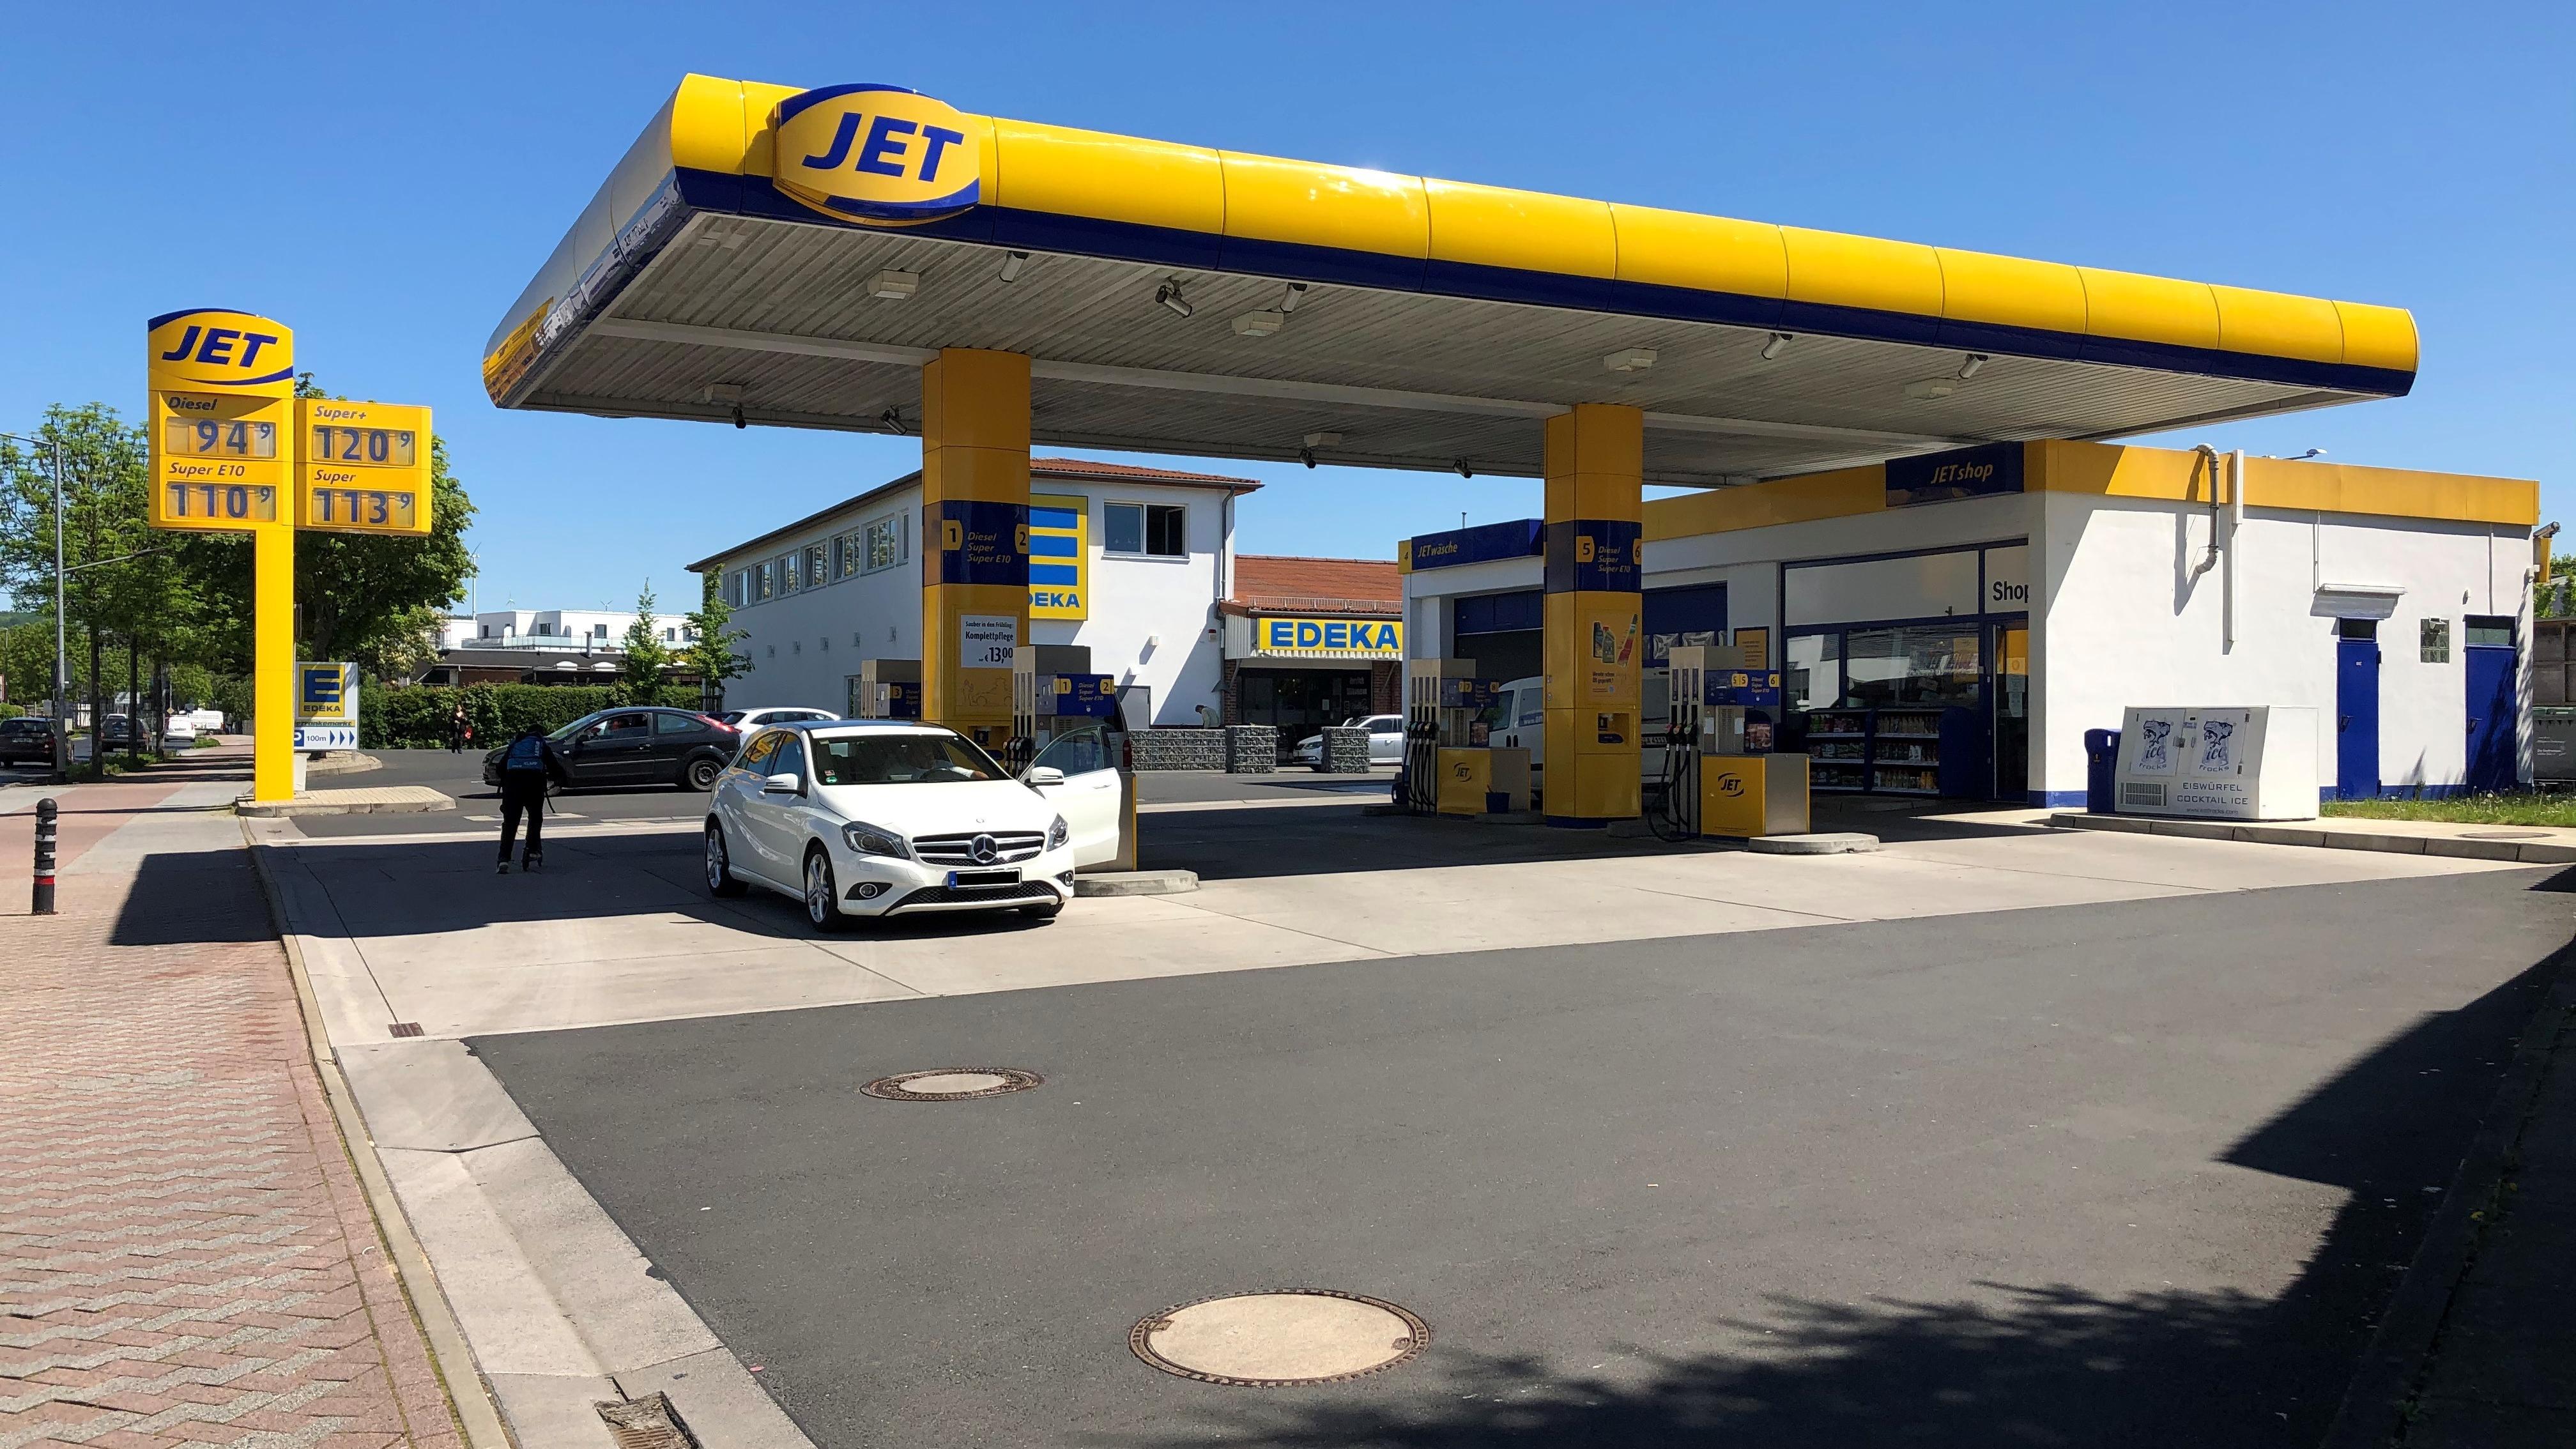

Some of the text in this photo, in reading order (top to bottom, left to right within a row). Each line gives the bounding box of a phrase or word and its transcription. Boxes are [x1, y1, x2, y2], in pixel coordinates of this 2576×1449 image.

[801, 112, 965, 183] JET
[162, 325, 279, 368] JET
[168, 396, 218, 411] Diesel
[314, 406, 367, 422] Super+
[168, 462, 246, 477] Super E10
[314, 469, 356, 483] Super
[949, 528, 1027, 546] 1 2
[967, 532, 997, 541] Diesel
[967, 543, 995, 553] Super
[1583, 542, 1640, 558] 5 6
[1598, 546, 1621, 554] Diesel
[967, 553, 1011, 564] Super E10
[1598, 555, 1619, 565] Super
[1598, 564, 1630, 574] Super E10
[965, 631, 1013, 642] Komplettpflege
[1271, 621, 1399, 649] EDEKA
[1062, 682, 1109, 691] 1 2
[1770, 677, 1775, 685] 6
[1456, 767, 1470, 777] JET
[1721, 779, 1742, 791] JET
[2182, 781, 2242, 792] EISWÜRFEL
[2177, 795, 2227, 804] COCKTAIL
